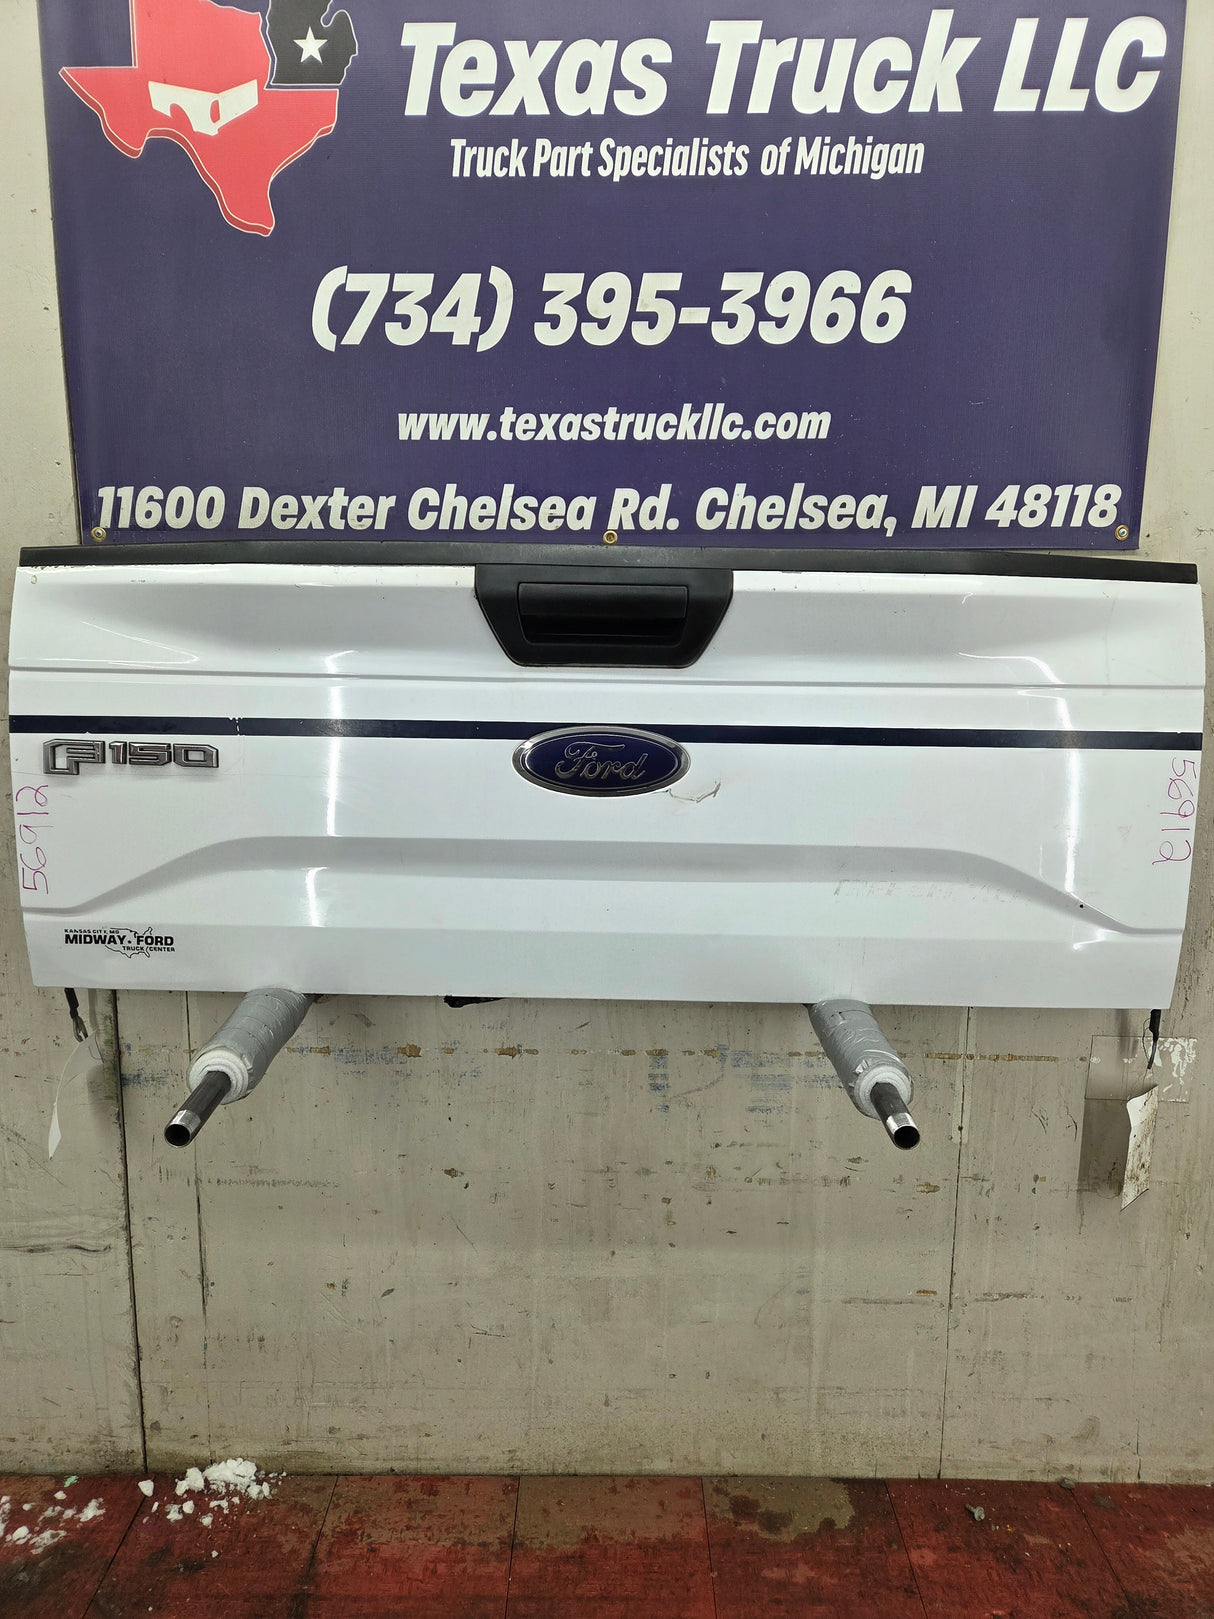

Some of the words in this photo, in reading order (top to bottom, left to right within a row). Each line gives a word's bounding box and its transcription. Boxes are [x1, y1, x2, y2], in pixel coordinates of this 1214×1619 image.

[401, 22, 672, 117] Texas
[706, 9, 981, 114] Truck
[993, 16, 1167, 112] LLC
[451, 139, 528, 178] Truck
[533, 138, 593, 178] Part
[598, 137, 749, 183] Specialists
[761, 137, 793, 176] of
[794, 135, 924, 181] Michigan
[312, 266, 513, 352] (734)
[534, 270, 912, 346] 395-3966
[398, 403, 831, 441] www.texastruckllc.com
[98, 486, 225, 529] 11600
[238, 487, 396, 530] Dexter
[408, 484, 597, 530] Chelsea
[607, 484, 679, 531] Rd.
[696, 483, 897, 538] Chelsea,
[911, 485, 978, 529] MI
[985, 484, 1122, 528] 48118
[43, 738, 219, 775] F150
[554, 741, 649, 780] Ford
[1152, 757, 1197, 865] 56912
[15, 784, 53, 894] 56912
[64, 934, 126, 945] MIDWAY
[136, 935, 174, 946] FORD
